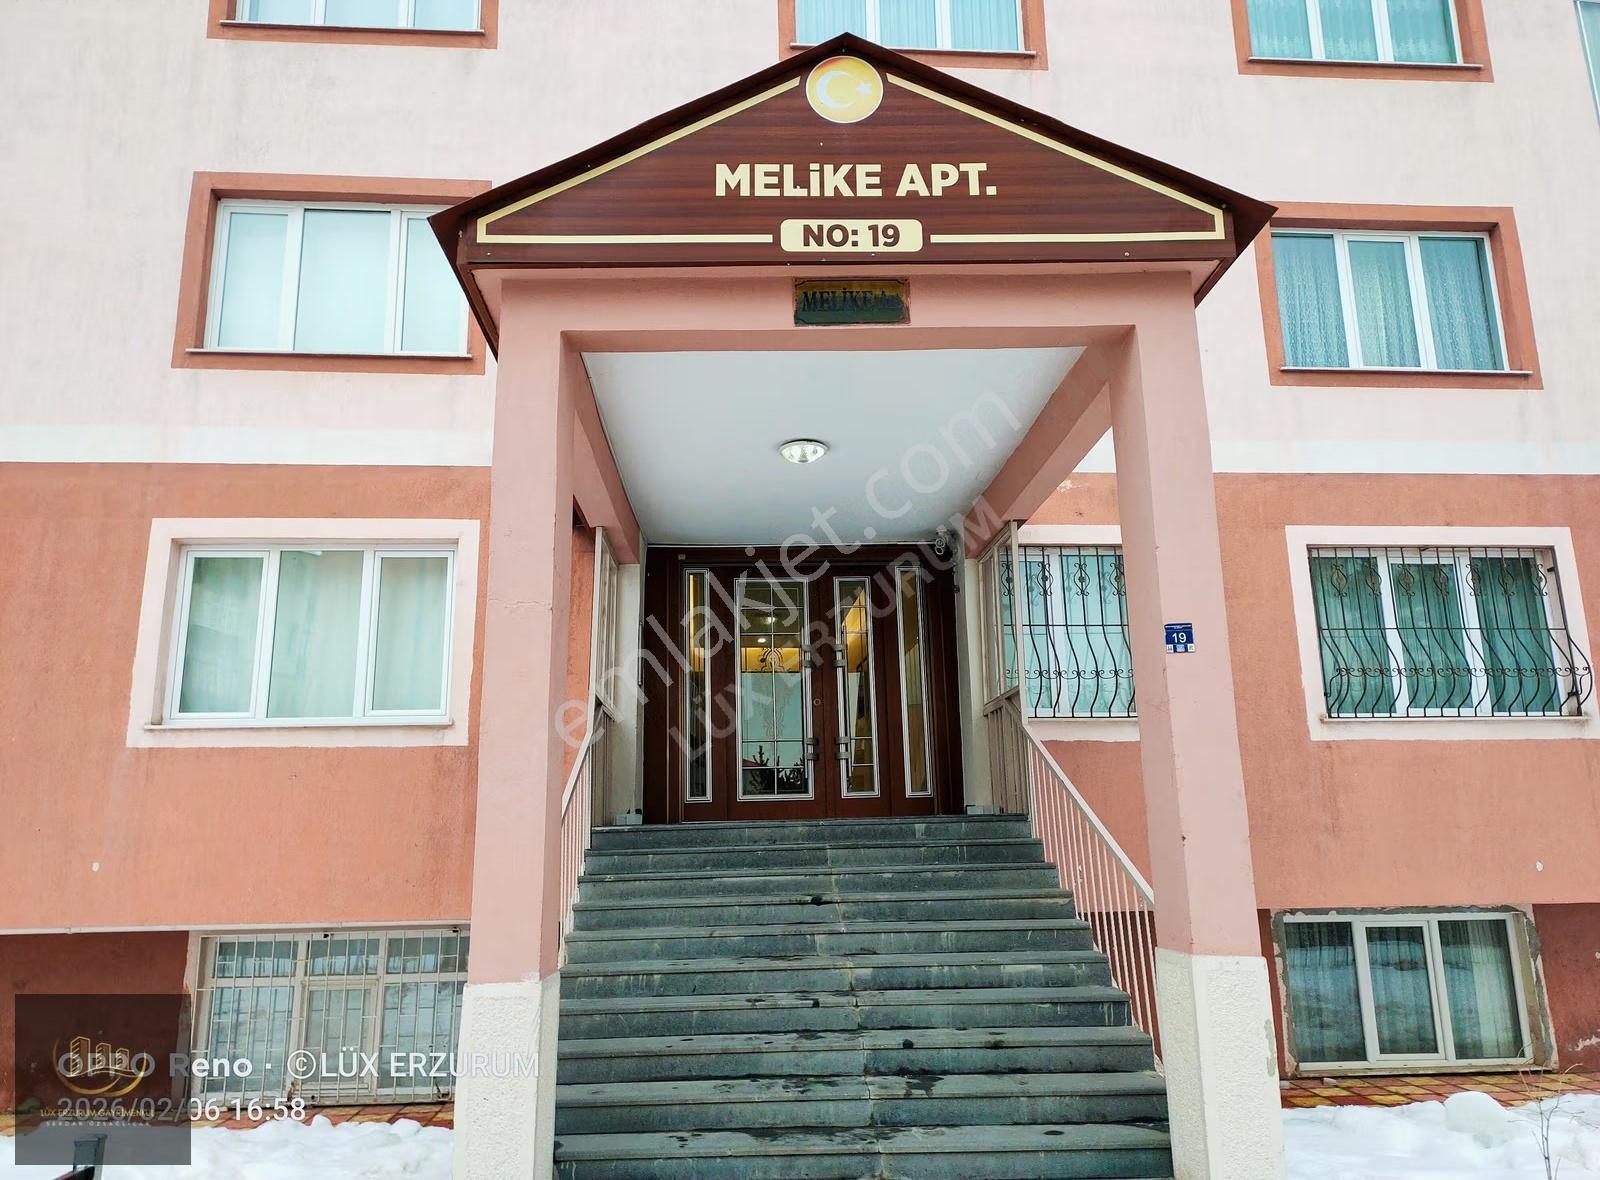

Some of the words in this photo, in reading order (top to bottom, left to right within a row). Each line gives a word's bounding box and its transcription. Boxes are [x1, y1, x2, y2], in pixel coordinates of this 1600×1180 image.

[896, 163, 998, 197] APT.
[802, 224, 859, 247] NO:
[867, 224, 900, 247] 19
[1172, 632, 1187, 643] 19
